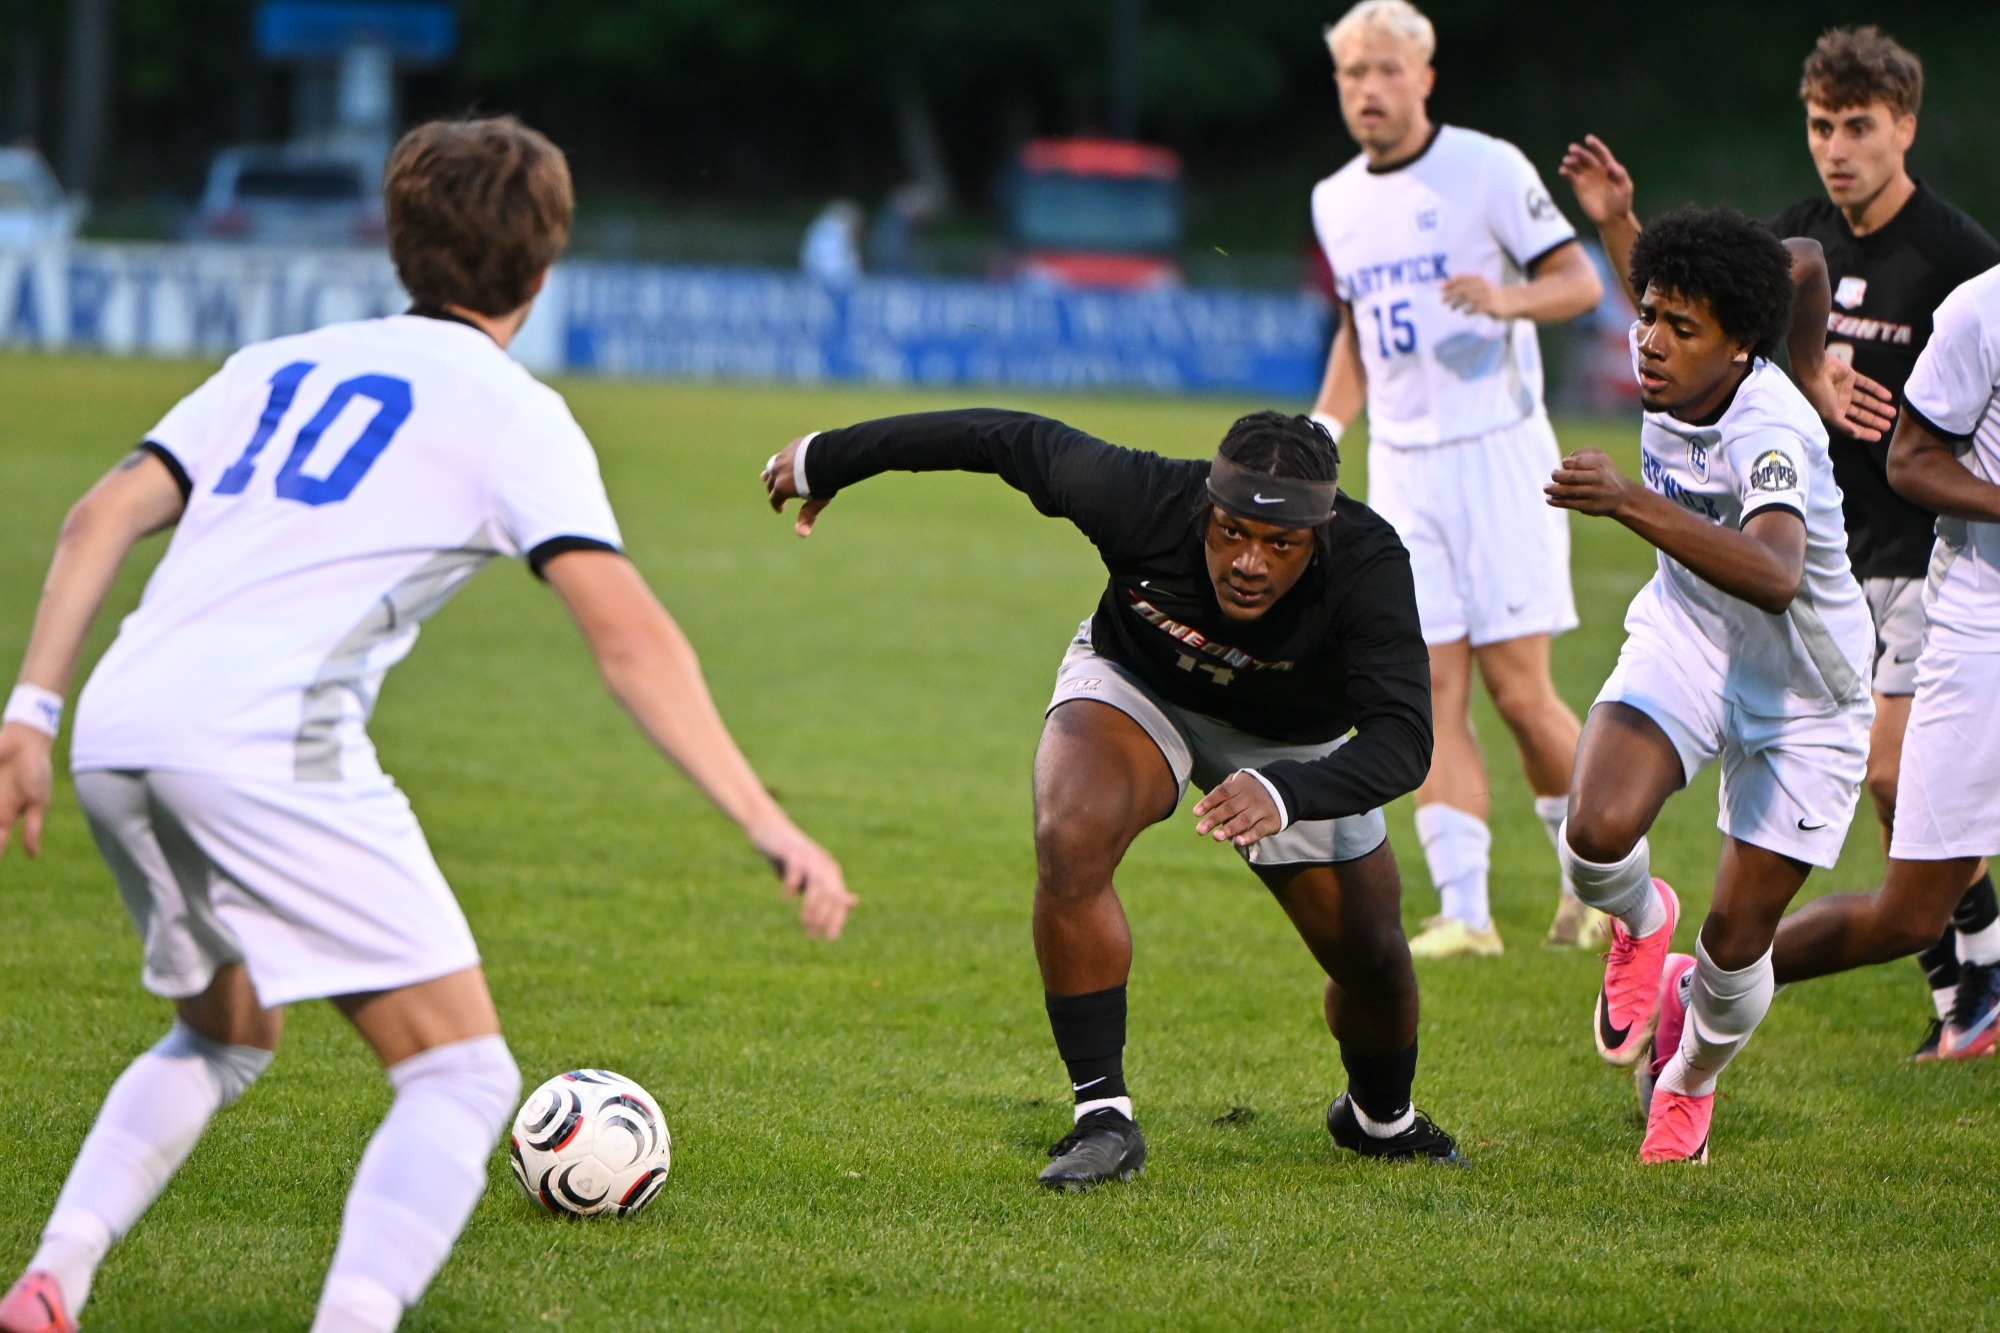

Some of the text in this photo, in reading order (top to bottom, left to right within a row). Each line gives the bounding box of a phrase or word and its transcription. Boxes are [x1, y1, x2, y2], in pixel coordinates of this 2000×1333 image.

[1373, 300, 1417, 359] 15
[211, 361, 415, 506] 10
[1131, 599, 1295, 671] ONEONTA
